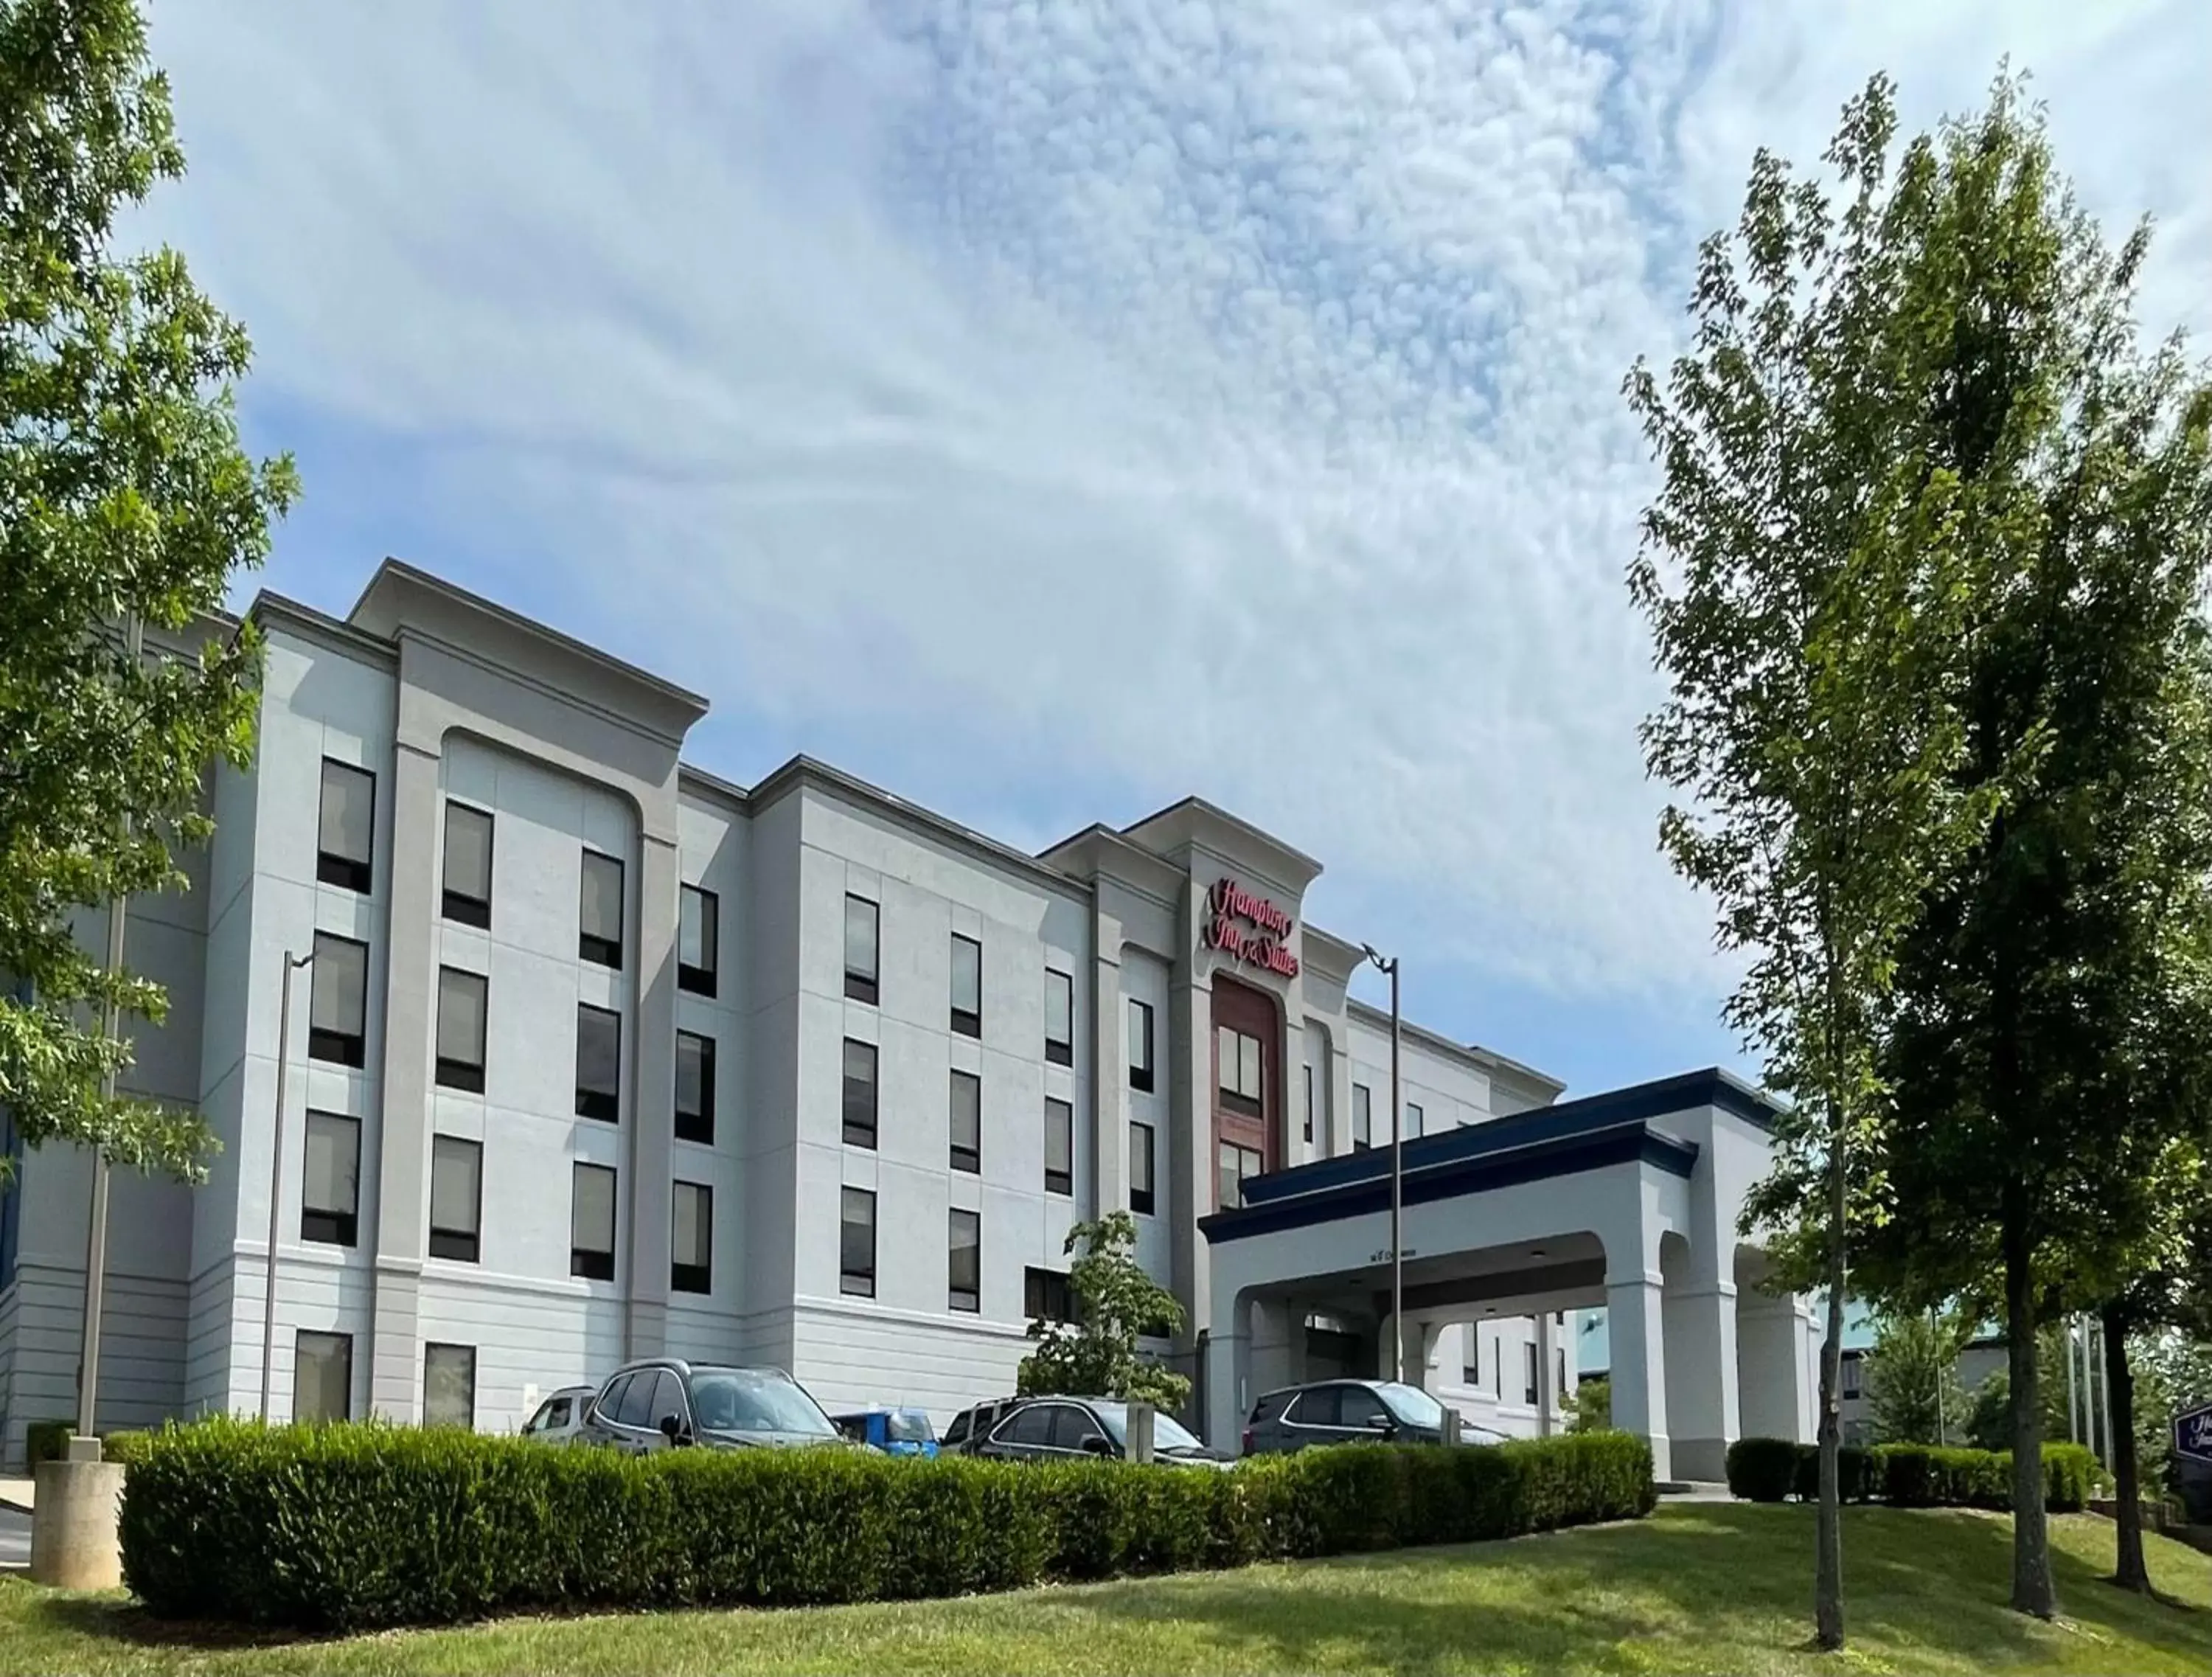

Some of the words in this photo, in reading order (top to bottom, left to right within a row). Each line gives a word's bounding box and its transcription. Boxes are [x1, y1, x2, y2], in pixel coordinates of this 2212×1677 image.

[1210, 878, 1293, 941] Hampton
[1205, 916, 1250, 959] Inn
[1258, 936, 1298, 977] Suites
